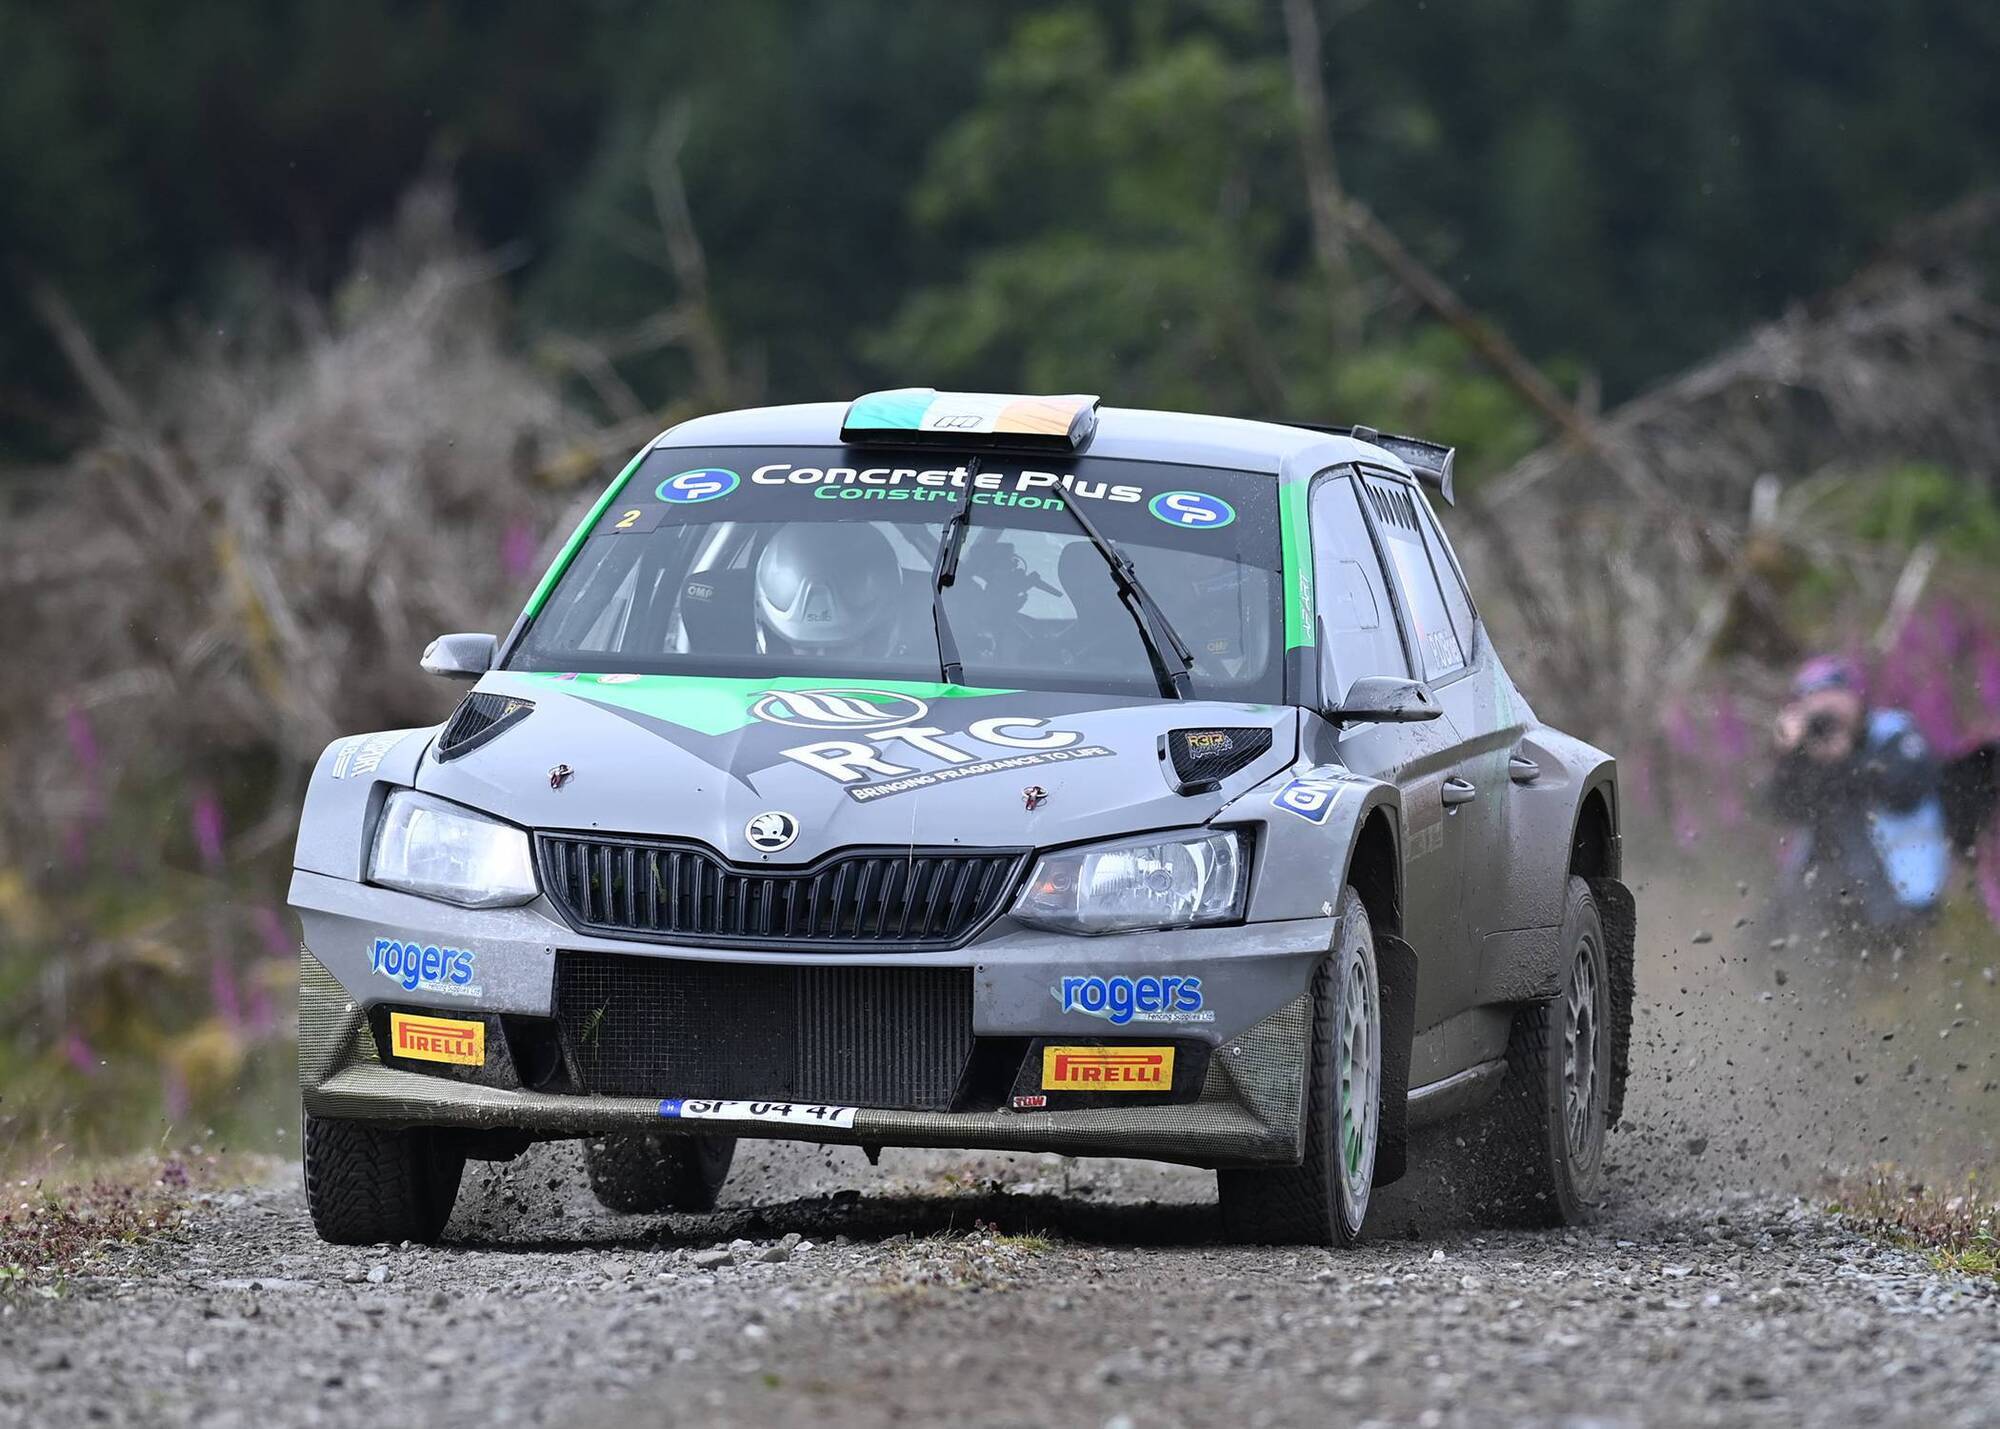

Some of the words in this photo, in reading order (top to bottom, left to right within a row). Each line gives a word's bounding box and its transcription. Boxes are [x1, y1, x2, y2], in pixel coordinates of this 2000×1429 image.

[672, 472, 722, 499] CP
[751, 464, 1004, 491] Concrete
[1015, 470, 1143, 503] Plus
[615, 509, 641, 528] 2
[1165, 495, 1217, 524] CP
[780, 717, 1077, 783] RTC
[851, 775, 937, 800] BRINGING
[934, 755, 1044, 780] FRAGRANCE
[1040, 752, 1069, 762] TO
[1067, 747, 1109, 758] LIFE
[374, 940, 474, 990] rogers
[1063, 977, 1202, 1023] rogers
[399, 1022, 475, 1056] PIRELLI
[1055, 1055, 1163, 1082] PIRELLI
